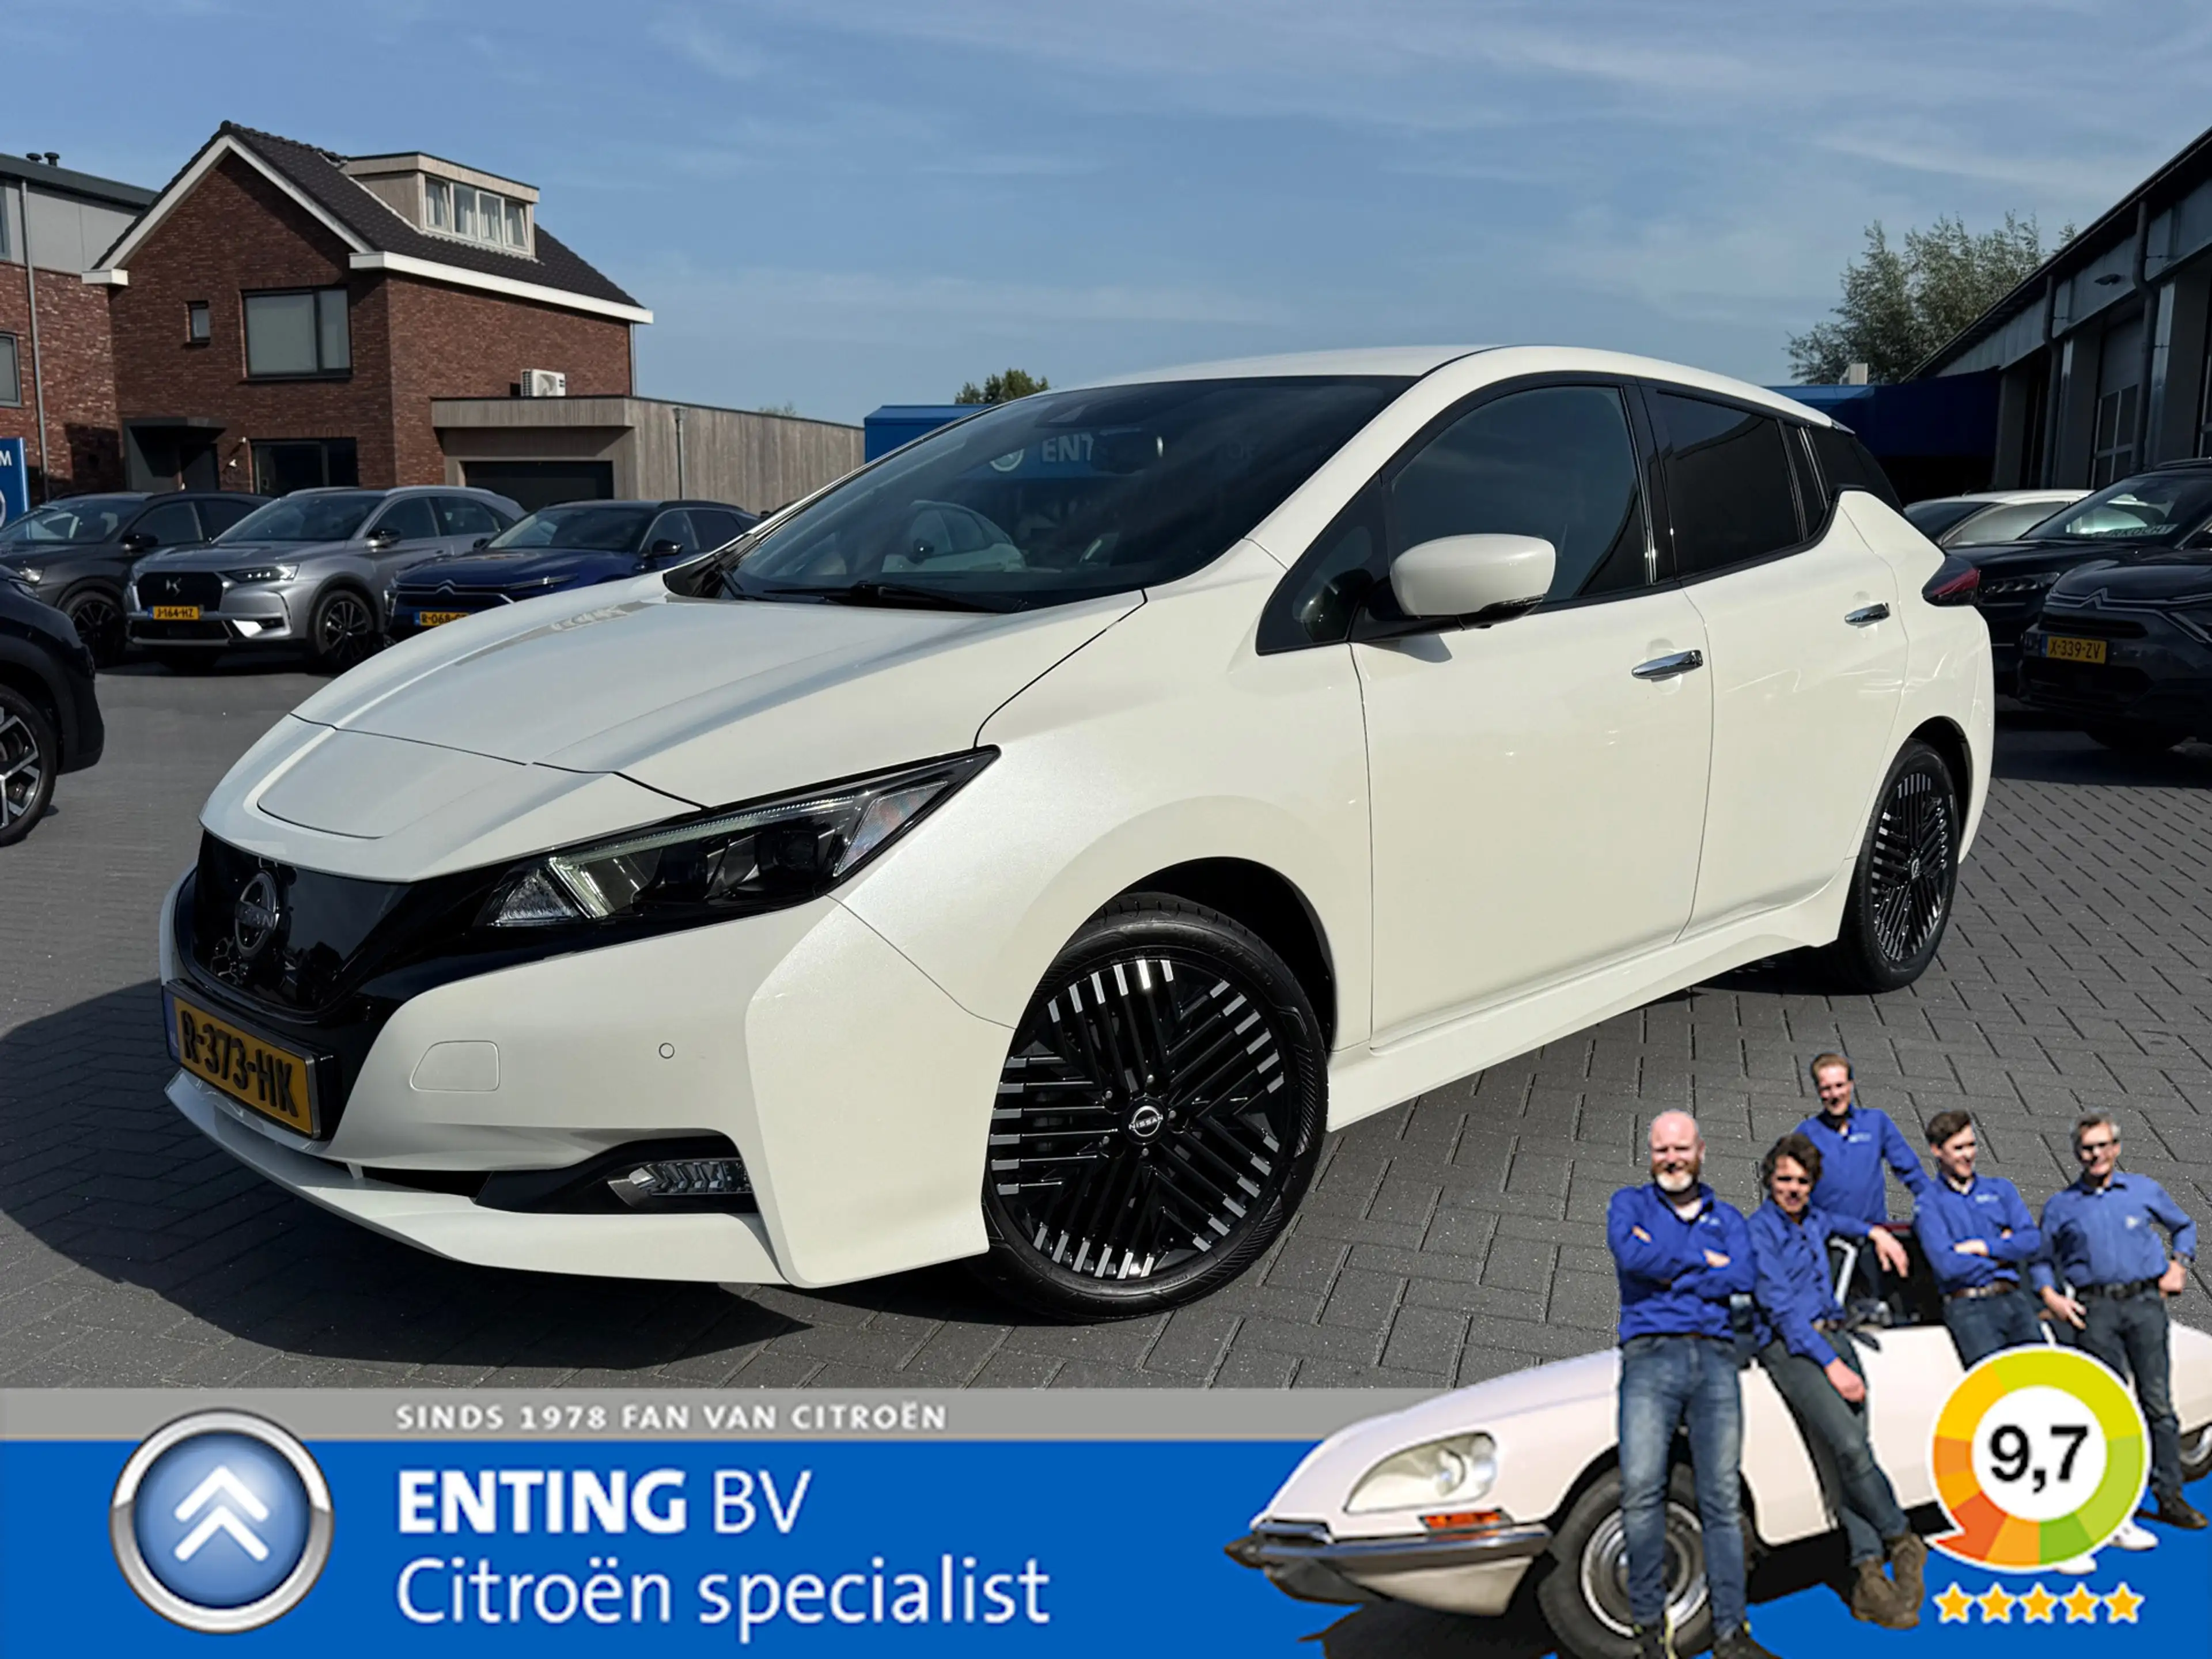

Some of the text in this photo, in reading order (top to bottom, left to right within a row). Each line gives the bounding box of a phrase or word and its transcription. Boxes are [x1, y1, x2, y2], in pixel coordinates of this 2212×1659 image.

[2050, 639, 2101, 659] X-339-ZV
[180, 1010, 299, 1118] R-373-HK
[1128, 1113, 1164, 1130] NISSAN
